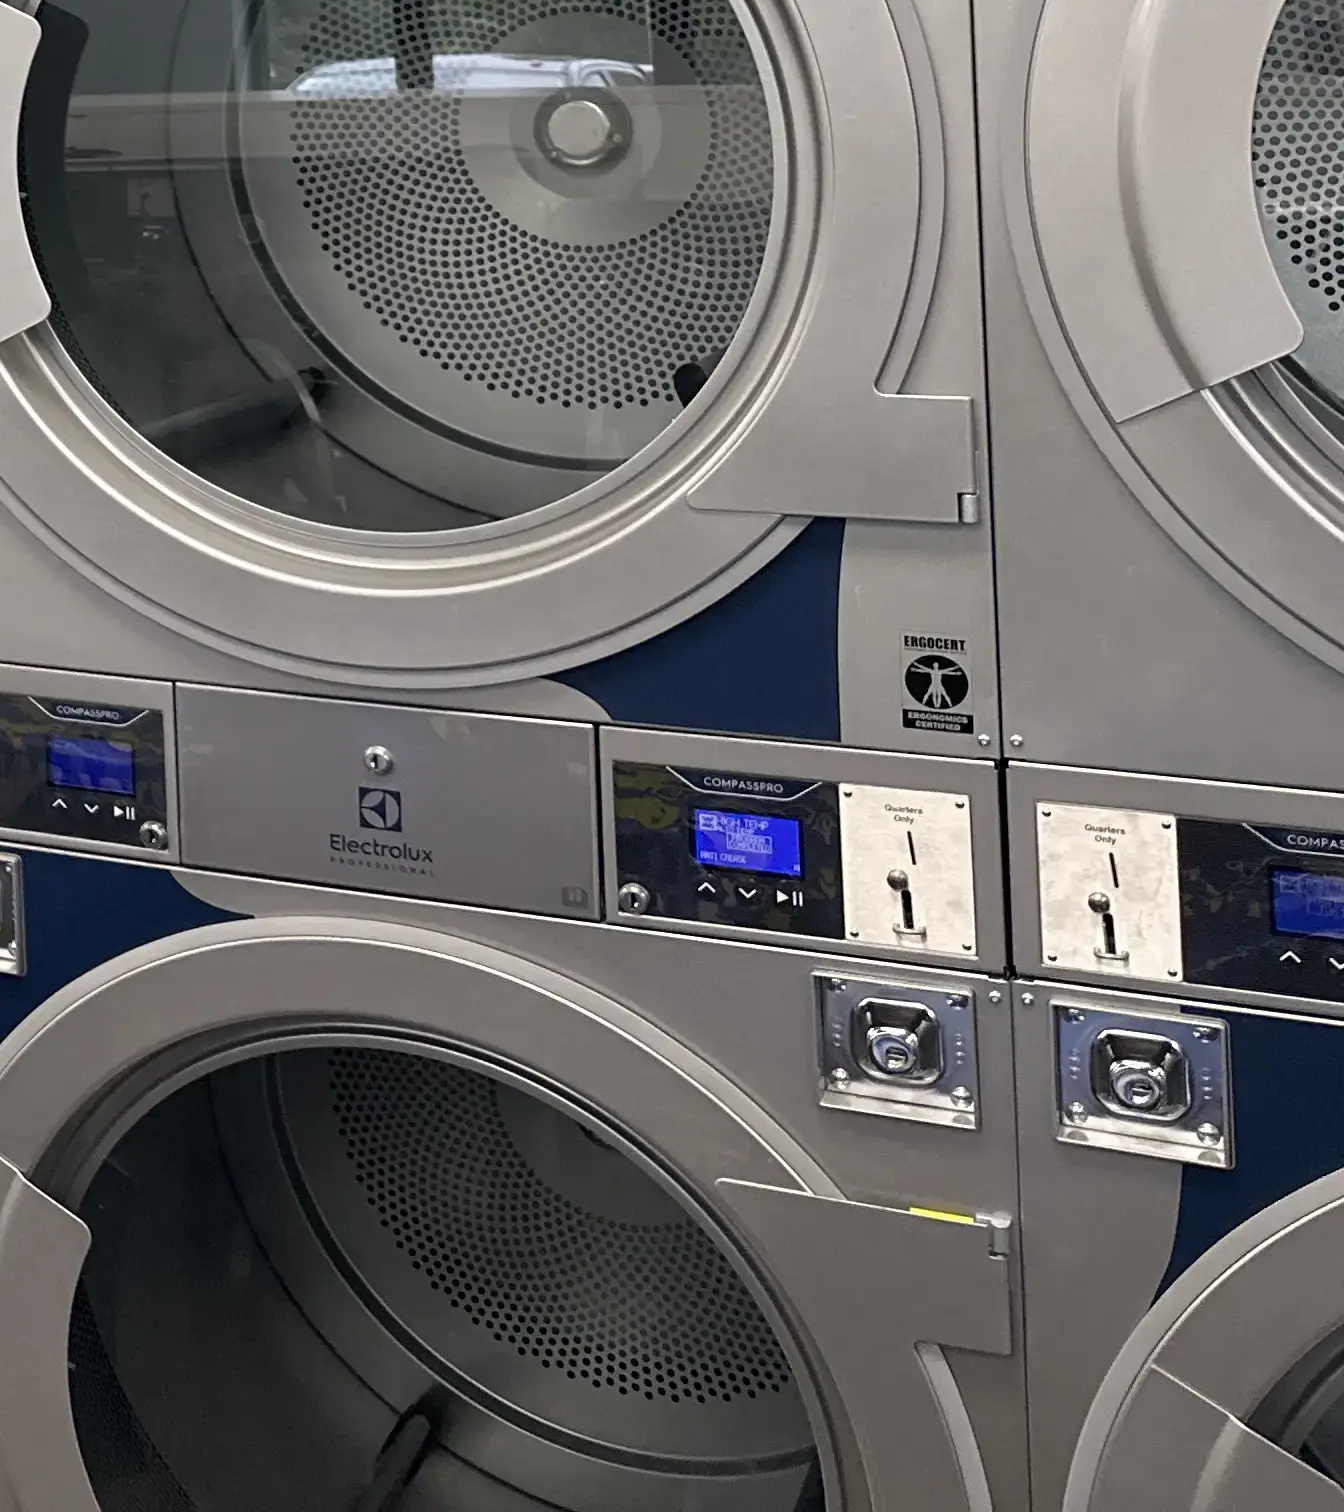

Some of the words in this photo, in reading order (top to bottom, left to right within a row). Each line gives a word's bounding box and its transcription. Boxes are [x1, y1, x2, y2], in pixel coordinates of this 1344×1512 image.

[903, 635, 966, 651] ERGOCERT
[56, 704, 120, 721] COMPASSPRO
[907, 711, 969, 724] ERGONOMICS
[915, 720, 961, 731] CERTIFIED
[703, 776, 784, 794] COMPASSPRO
[884, 803, 923, 815] Quarters
[893, 814, 915, 825] Only
[1084, 823, 1126, 835] Quarters
[1094, 834, 1117, 846] Only
[329, 833, 434, 863] Electrolux
[329, 855, 435, 877] PROFESSIONAL
